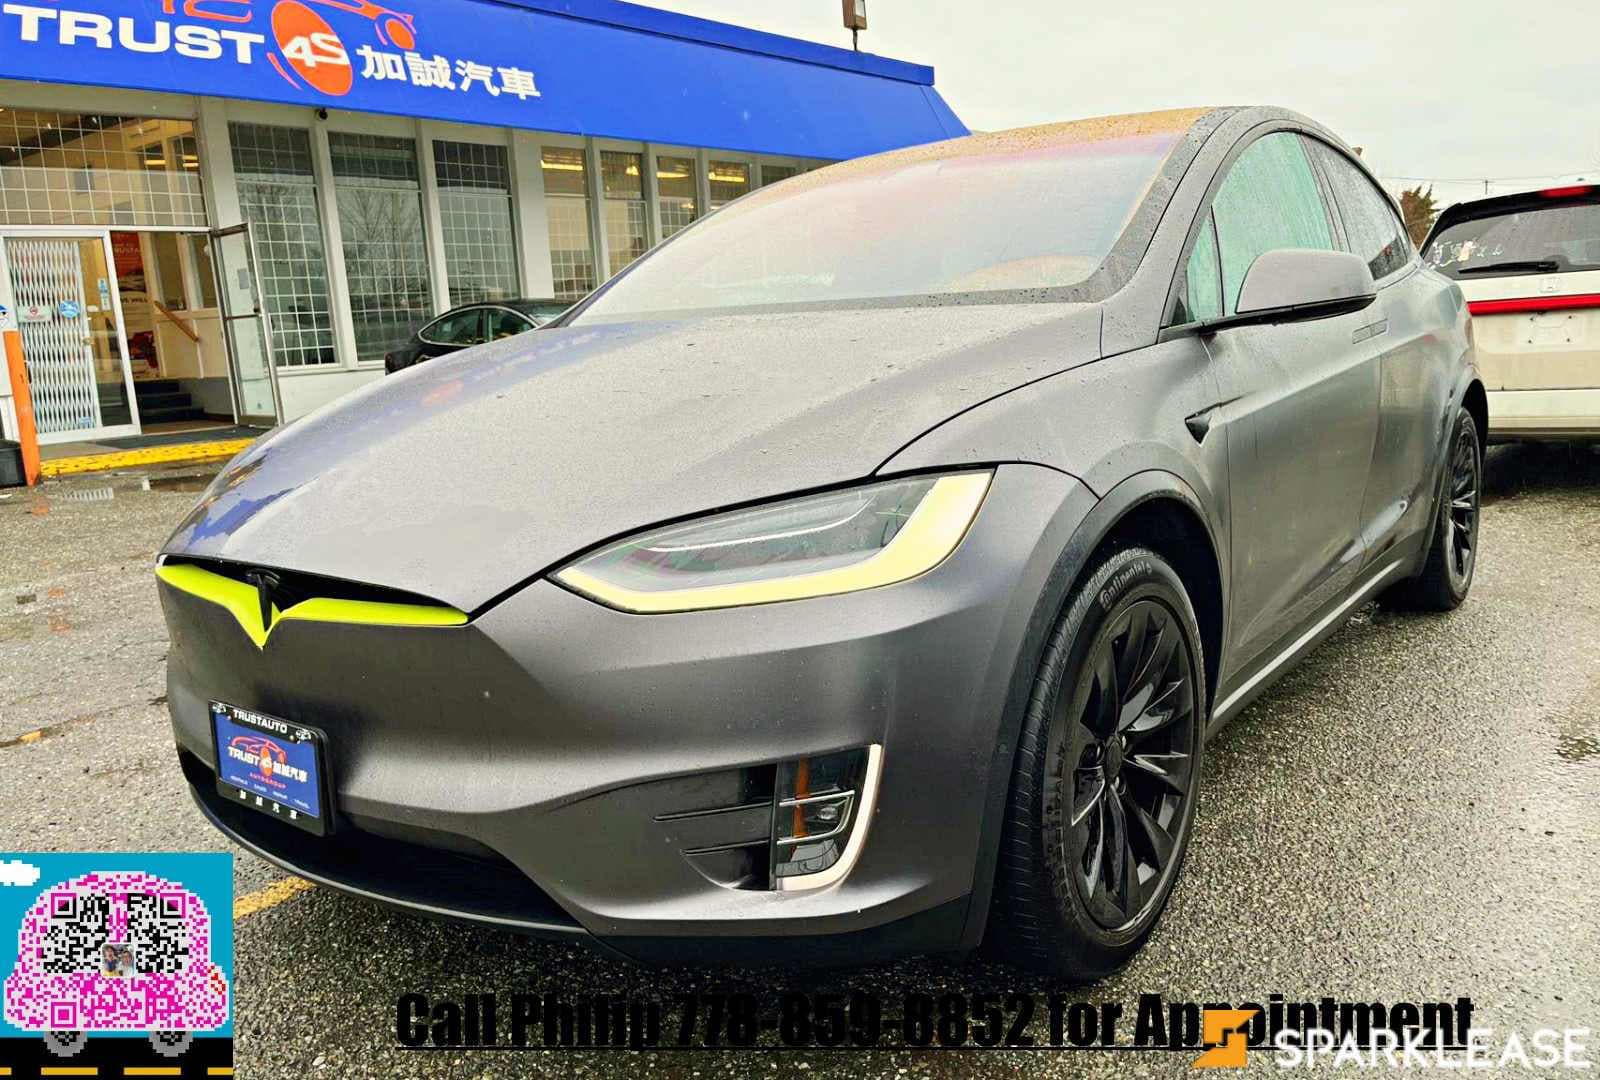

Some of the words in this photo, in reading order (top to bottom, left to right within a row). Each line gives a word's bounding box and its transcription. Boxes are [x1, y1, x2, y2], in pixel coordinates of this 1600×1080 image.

[3, 3, 265, 64] TRUST
[281, 32, 350, 67] 4S
[356, 45, 541, 100] 加誠汽車
[233, 709, 288, 733] TRUSTAUTO
[228, 746, 260, 767] TRUST
